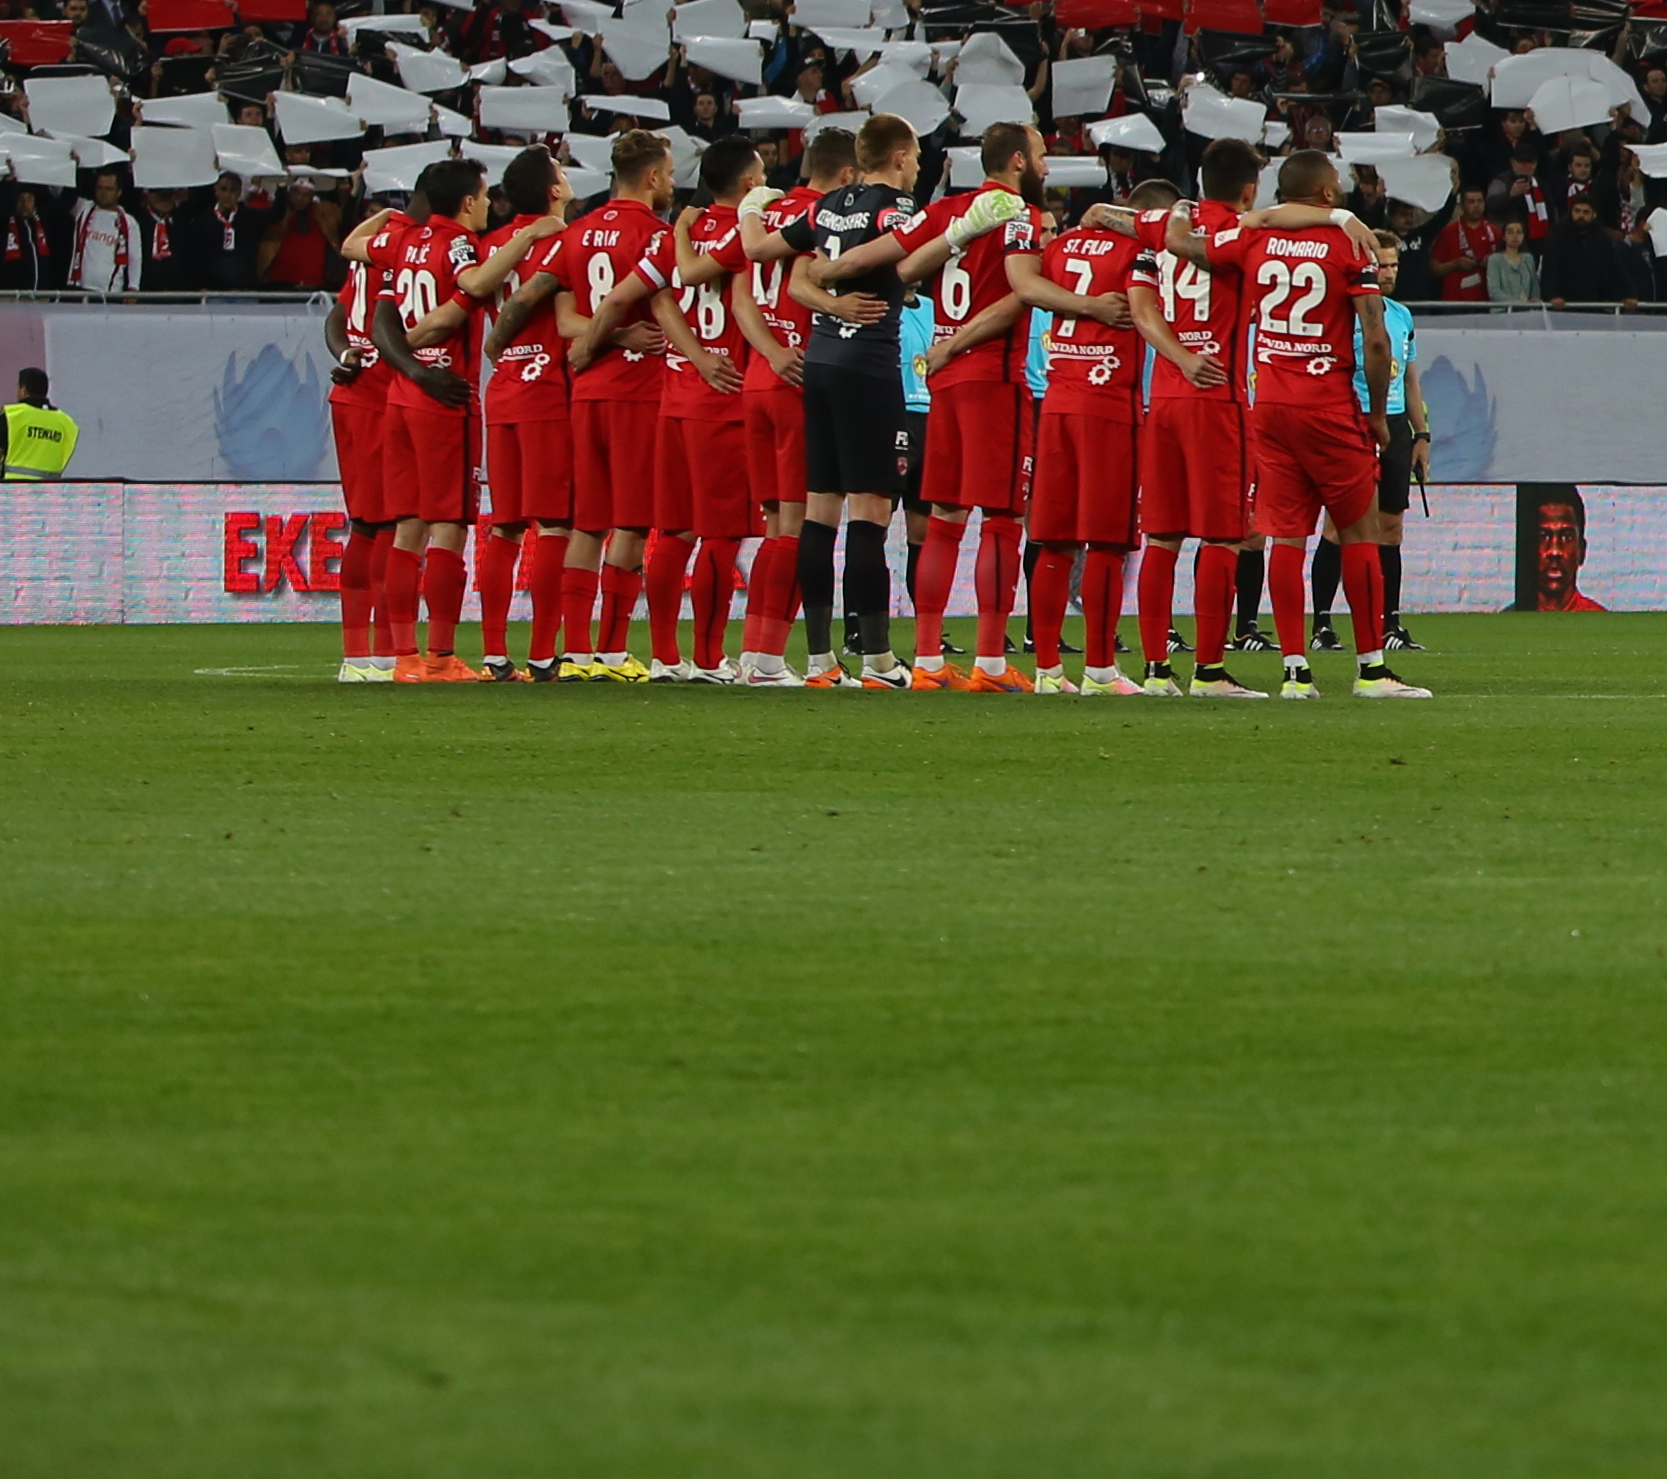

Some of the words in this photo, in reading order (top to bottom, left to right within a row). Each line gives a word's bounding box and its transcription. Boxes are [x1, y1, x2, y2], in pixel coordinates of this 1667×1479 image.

[582, 229, 620, 247] ERIK
[1081, 240, 1115, 256] FILIP
[1265, 237, 1330, 259] ROMARIO
[396, 268, 439, 333] 20
[587, 252, 615, 314] 8
[941, 249, 972, 321] 6
[1056, 258, 1095, 339] 7
[1155, 248, 1212, 323] 14
[1256, 259, 1327, 337] 22
[1177, 330, 1213, 342] NORD
[1293, 342, 1333, 354] NORD
[27, 425, 63, 444] STEWARD
